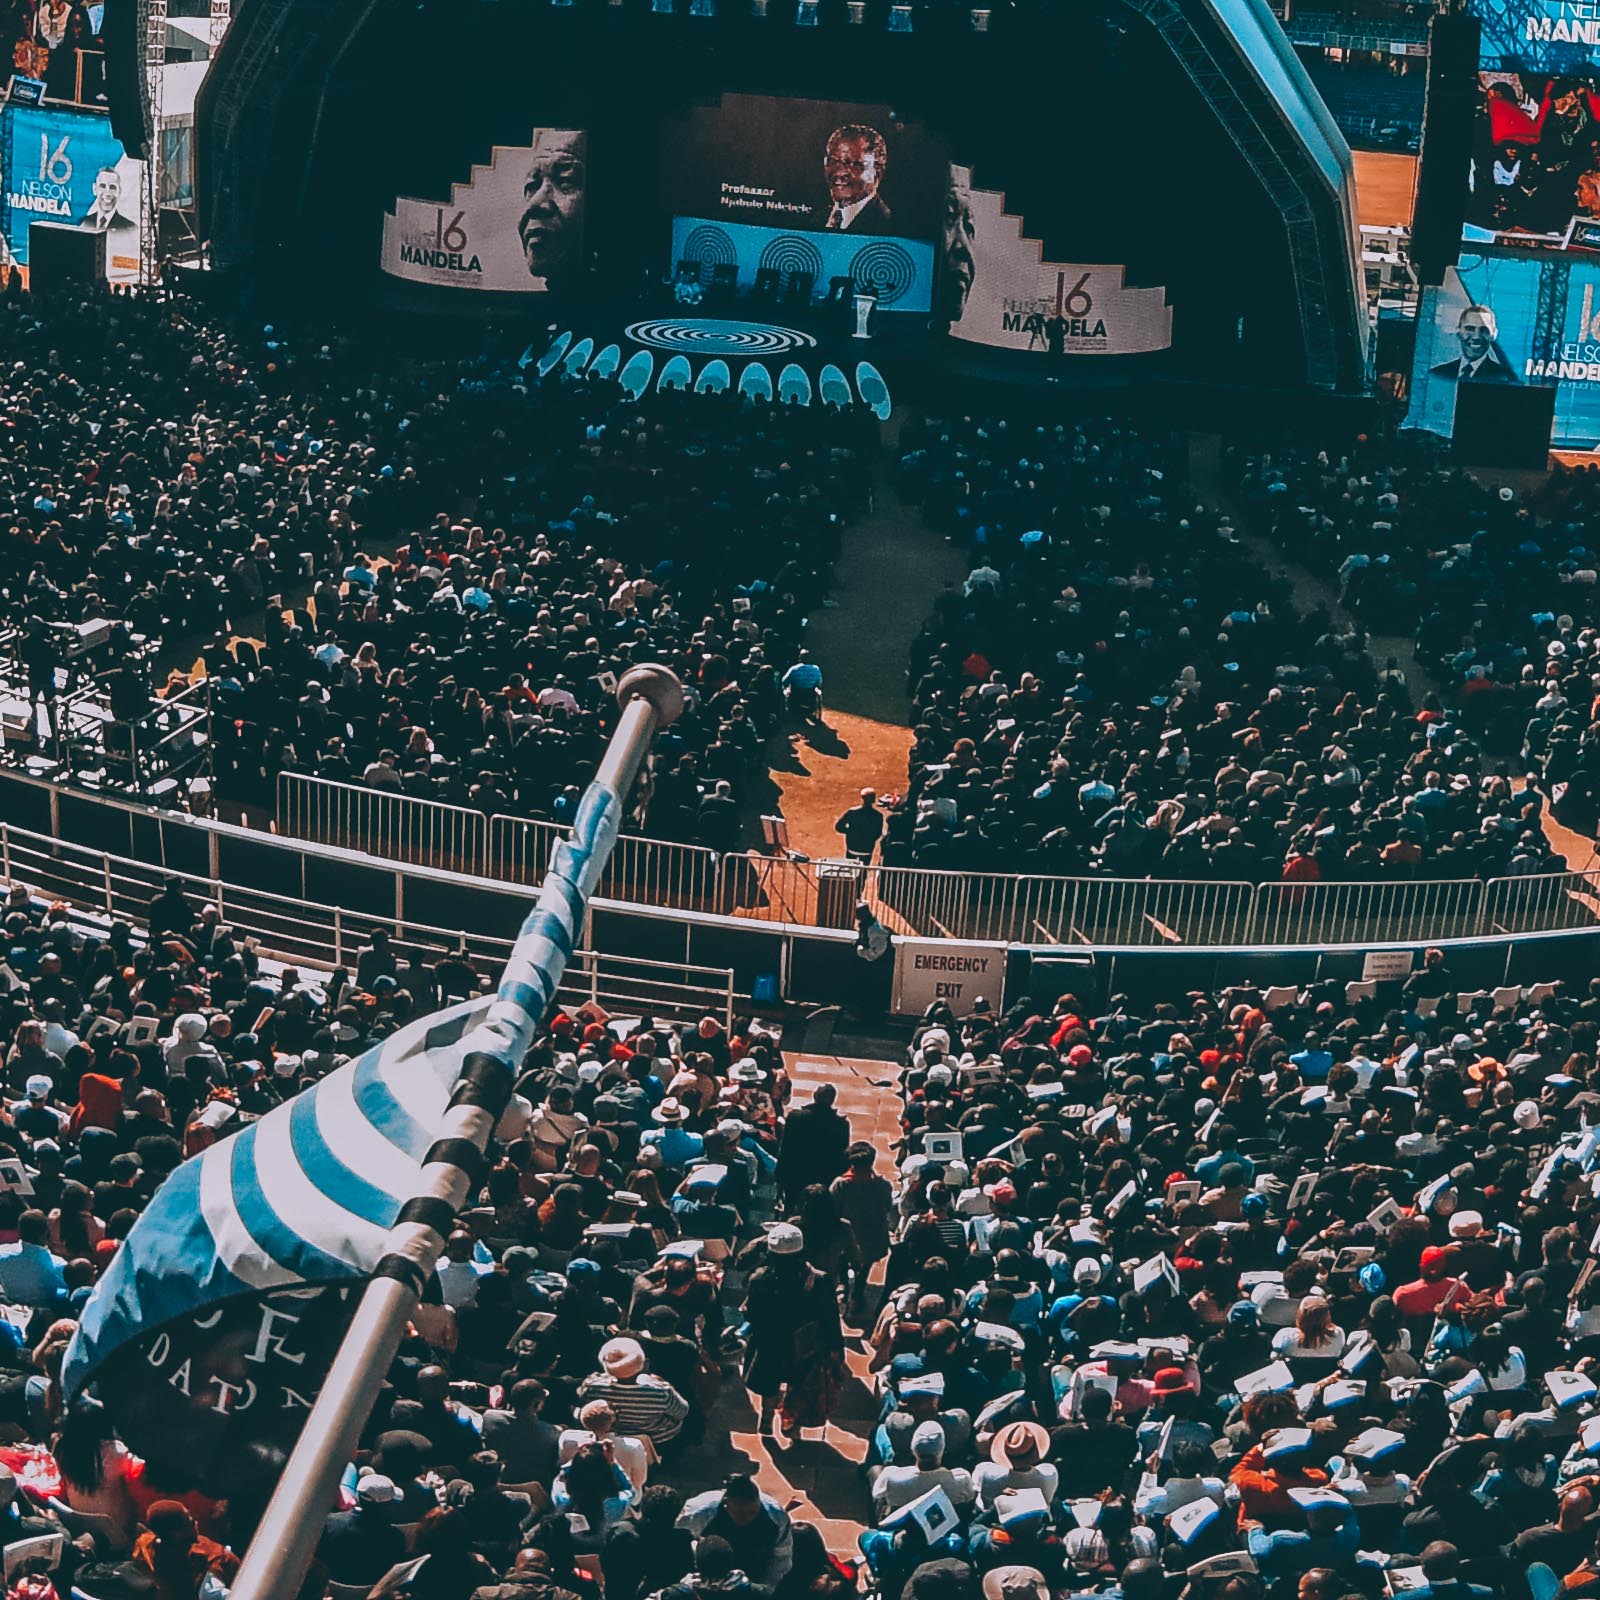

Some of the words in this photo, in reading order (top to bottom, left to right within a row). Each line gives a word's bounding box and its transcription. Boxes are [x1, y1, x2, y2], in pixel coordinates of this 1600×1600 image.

[39, 133, 72, 185] 16
[22, 180, 72, 201] NELSON
[6, 193, 72, 216] MANDELA
[436, 208, 466, 252] 16
[400, 244, 482, 272] MANDELA
[1056, 272, 1092, 317] 16
[914, 954, 988, 973] EMERGENCY
[935, 982, 963, 999] EXIT
